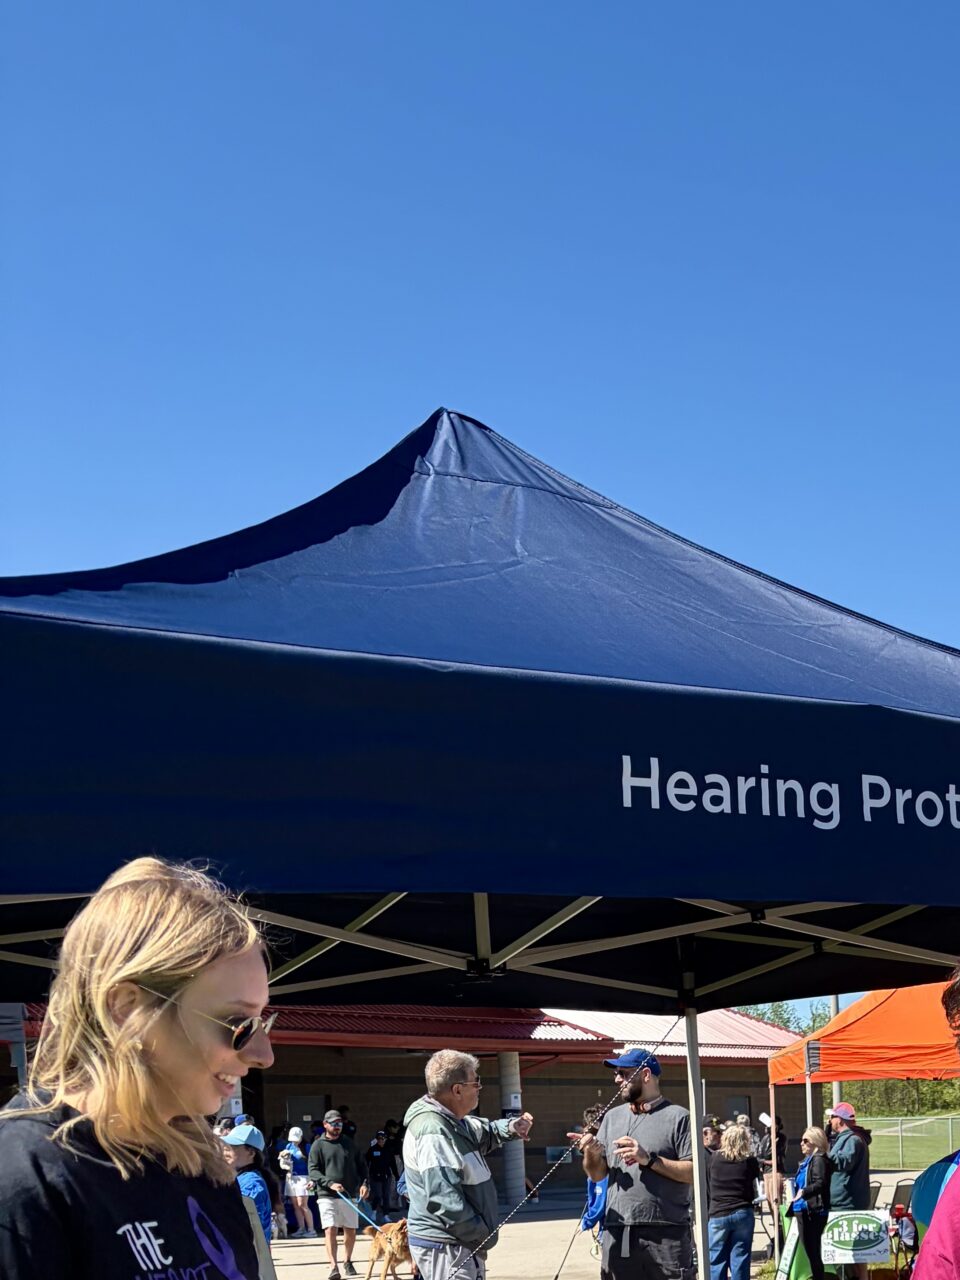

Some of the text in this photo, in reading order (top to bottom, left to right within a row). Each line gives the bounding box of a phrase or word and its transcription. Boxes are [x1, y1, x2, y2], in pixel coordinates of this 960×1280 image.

[621, 755, 841, 829] Hearing
[823, 1228, 888, 1245] glasses
[839, 1220, 848, 1232] 3
[852, 1220, 877, 1231] for
[116, 1221, 173, 1271] THE
